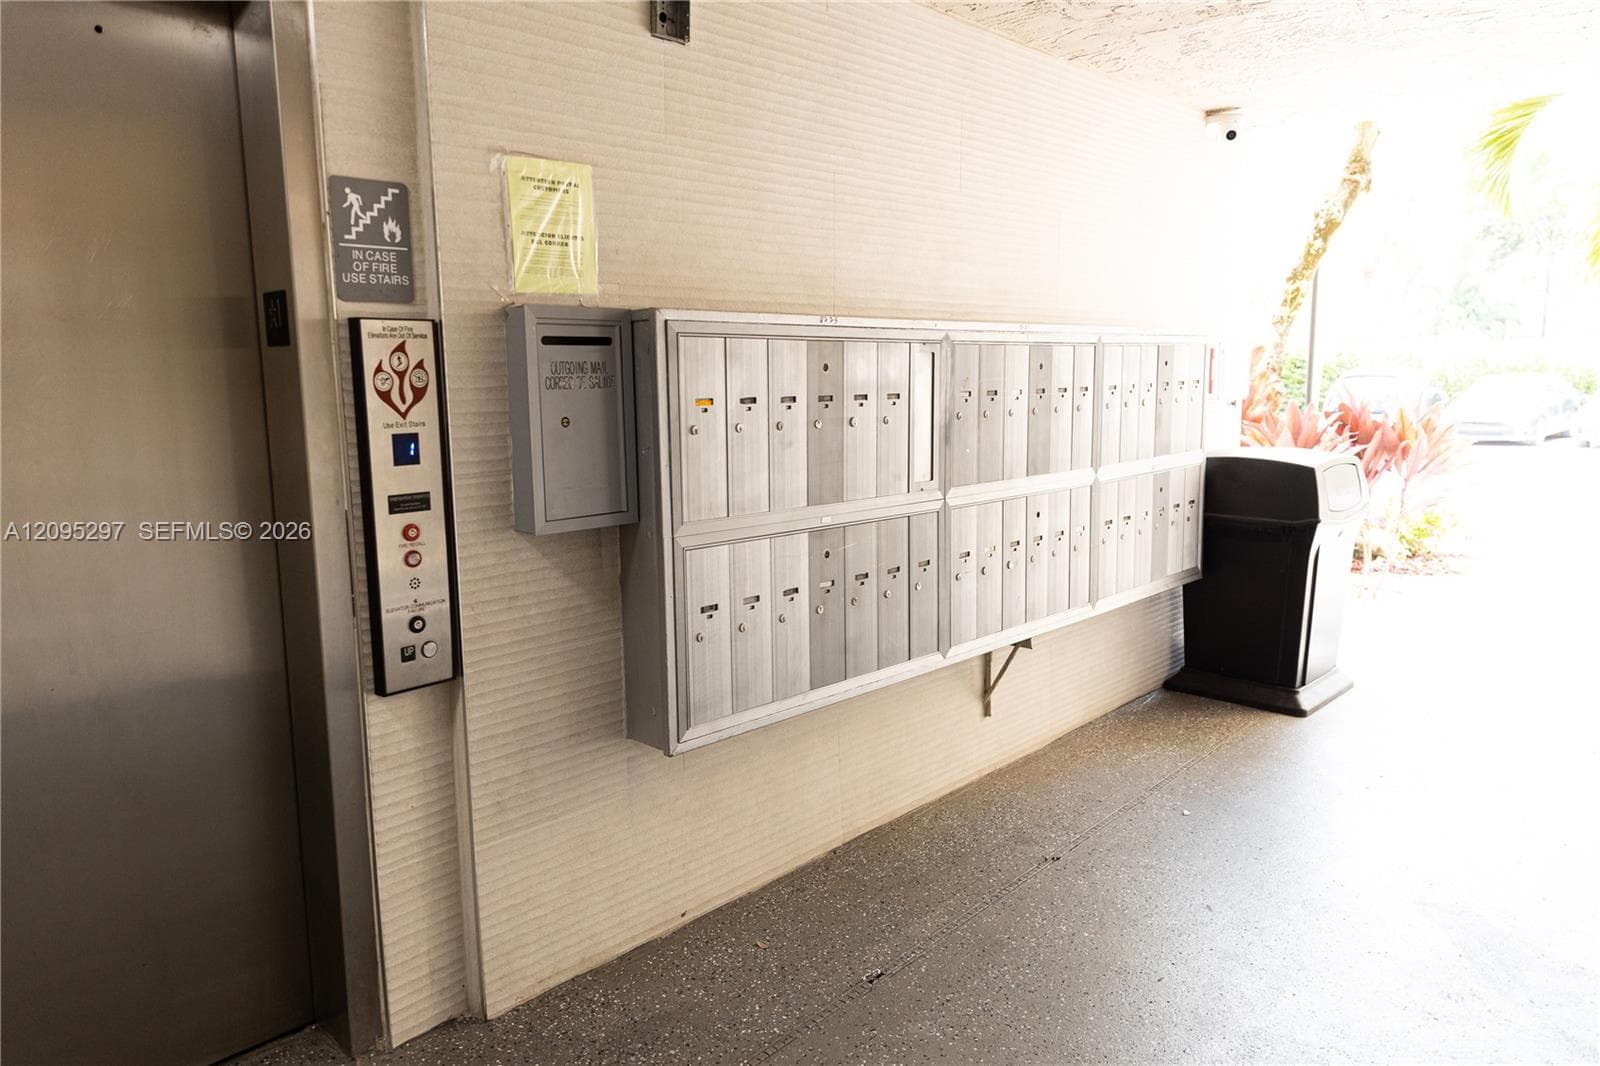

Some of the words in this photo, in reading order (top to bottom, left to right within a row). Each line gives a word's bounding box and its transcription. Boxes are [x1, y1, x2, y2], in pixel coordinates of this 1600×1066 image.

[557, 180, 580, 188] POTAL
[352, 250, 363, 260] IN
[366, 251, 397, 262] CASE
[353, 262, 369, 272] OF
[372, 263, 398, 274] FIRE
[342, 273, 367, 284] USE
[370, 274, 410, 286] STAIRS
[550, 360, 588, 375] OUTGOING
[590, 360, 608, 375] MAIL
[410, 442, 415, 456] 1
[404, 646, 415, 656] UP
